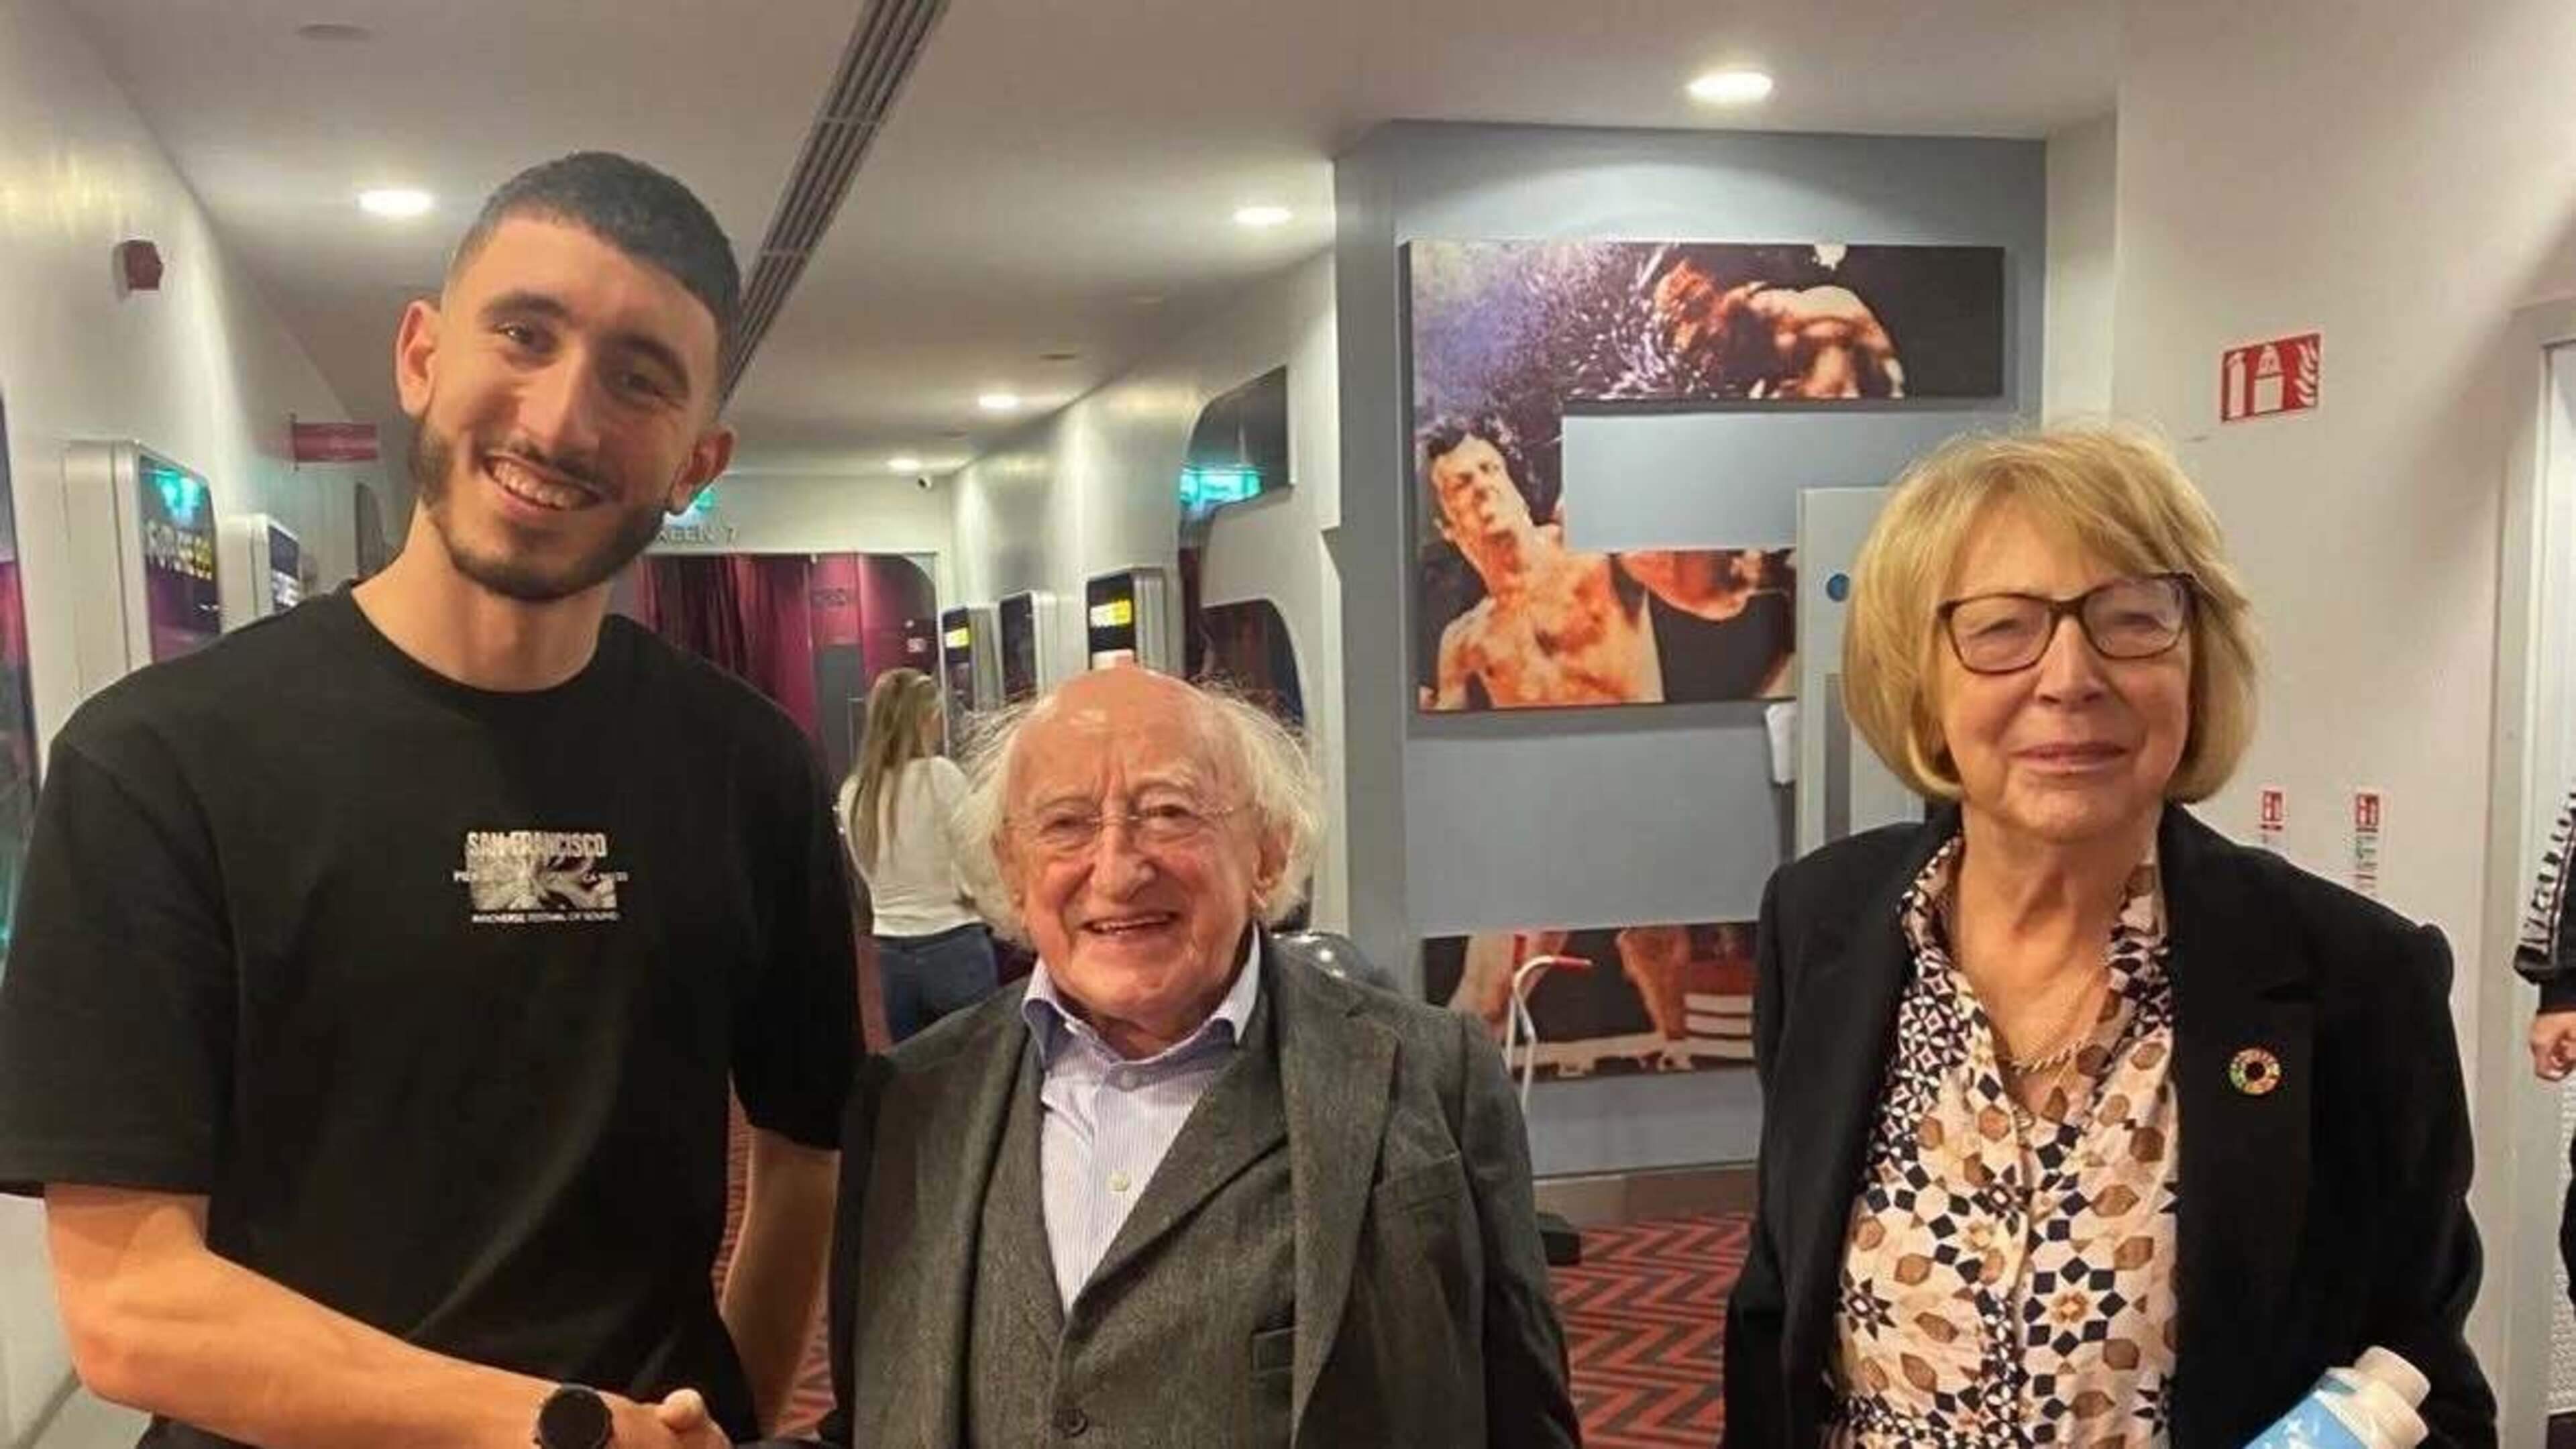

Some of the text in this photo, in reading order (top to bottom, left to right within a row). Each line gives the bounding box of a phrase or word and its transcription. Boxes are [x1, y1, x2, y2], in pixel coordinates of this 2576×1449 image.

[655, 528, 715, 543] REEN
[467, 830, 607, 858] SAN FRANCISCO
